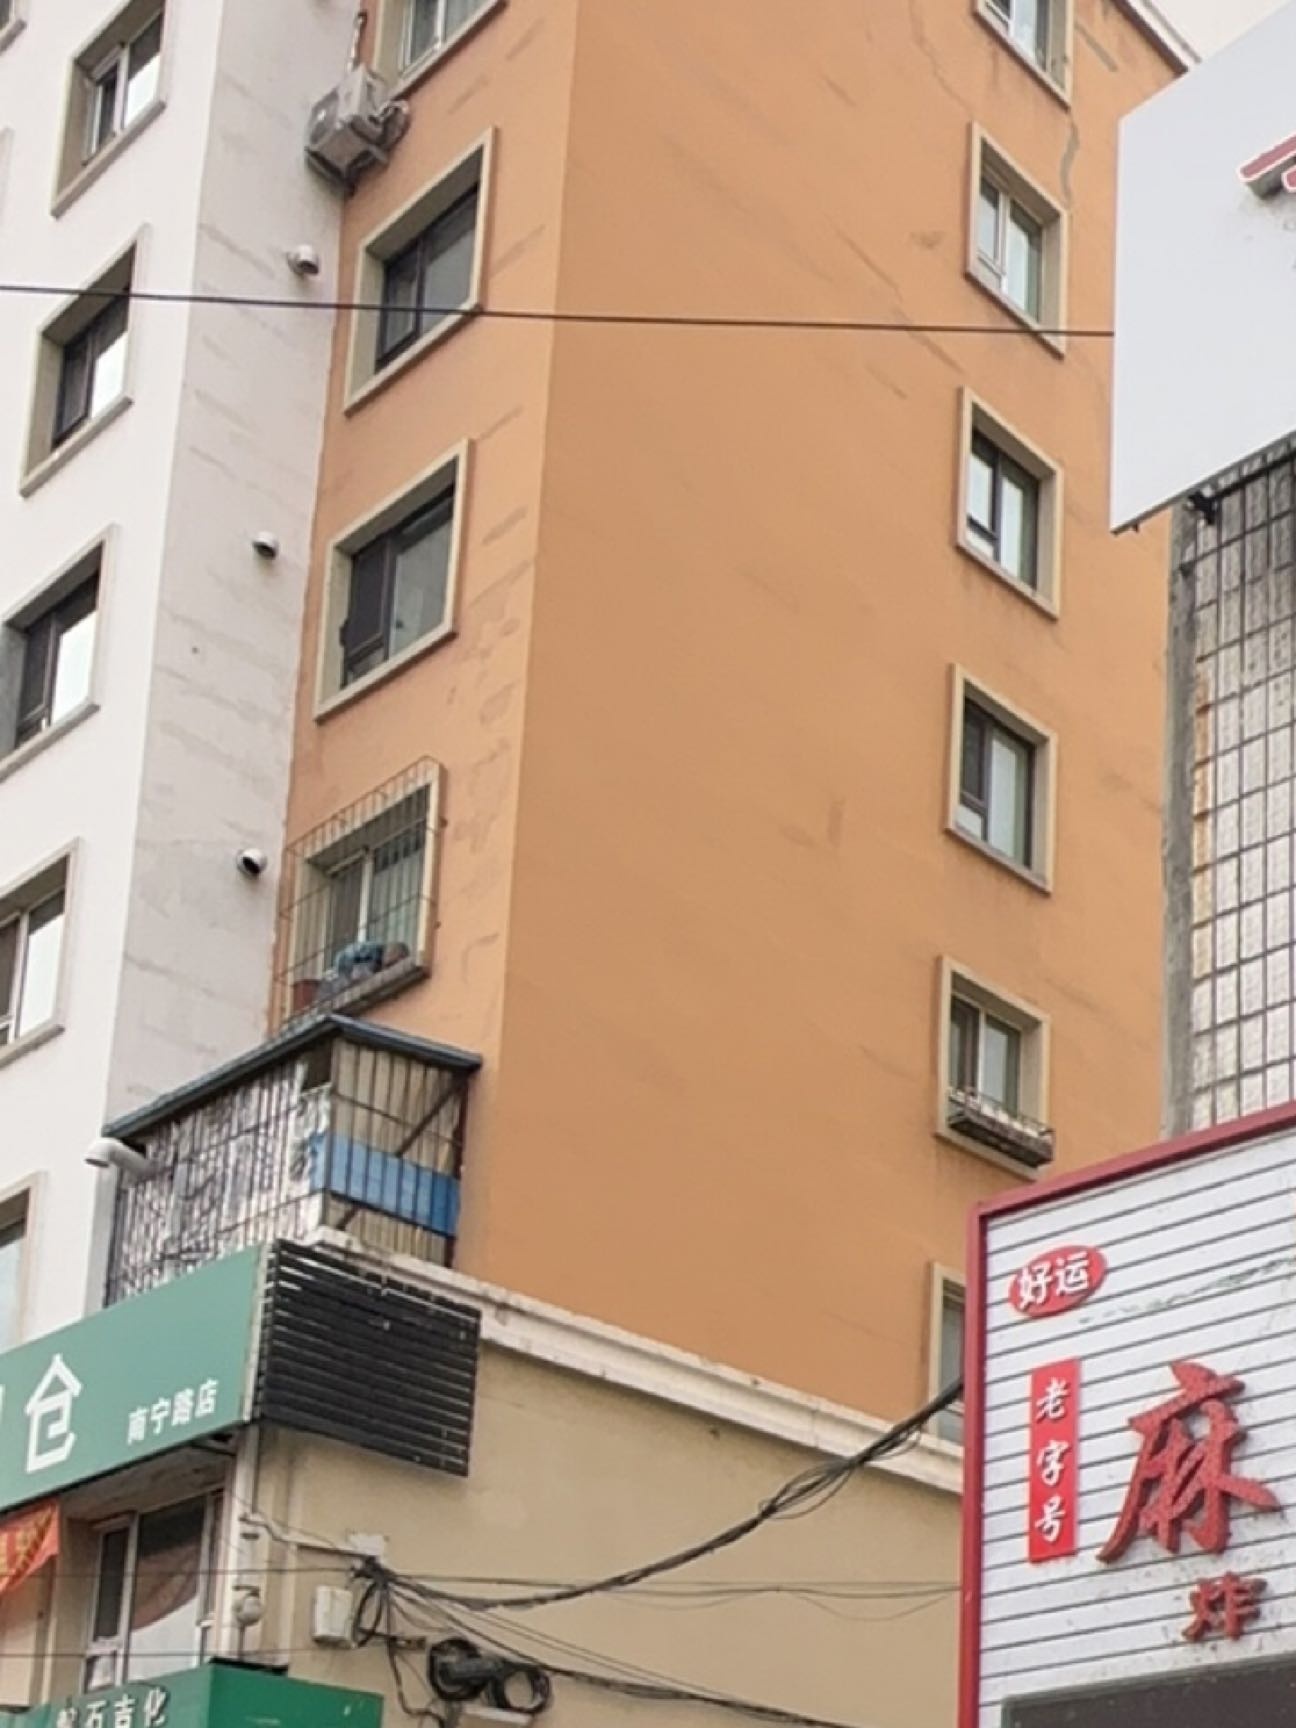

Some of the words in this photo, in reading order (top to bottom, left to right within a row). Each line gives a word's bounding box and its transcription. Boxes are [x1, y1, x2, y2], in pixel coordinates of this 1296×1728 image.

[1015, 1251, 1089, 1310] 好运
[0, 1353, 83, 1474] 仓
[1033, 1378, 1067, 1543] 老字号
